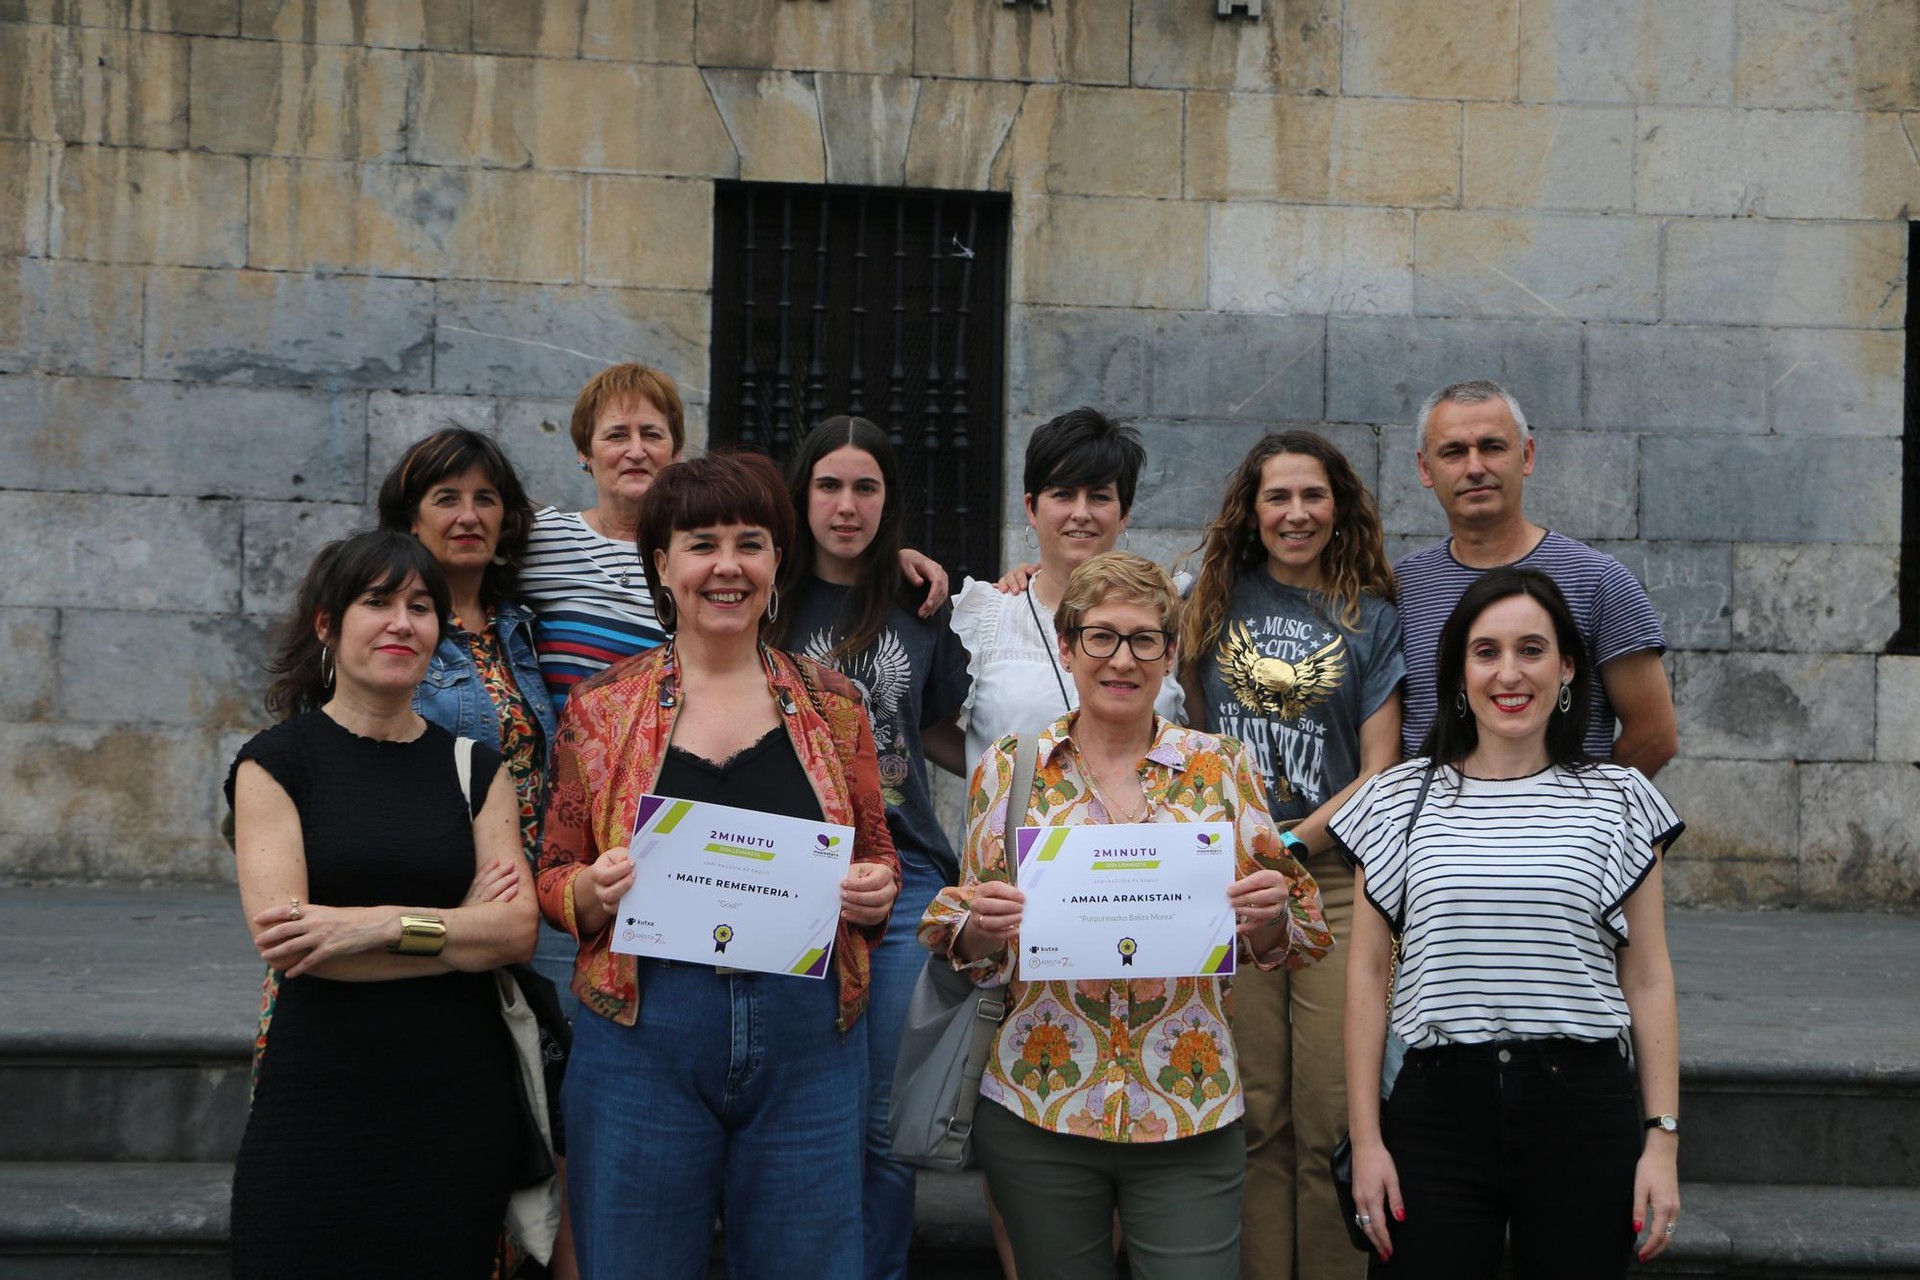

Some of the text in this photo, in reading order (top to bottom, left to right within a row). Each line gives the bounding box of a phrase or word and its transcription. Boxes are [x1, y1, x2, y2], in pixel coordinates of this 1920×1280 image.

[1262, 616, 1312, 640] MUSIC
[1265, 639, 1302, 660] CITY
[1227, 702, 1314, 733] 19 50
[710, 830, 774, 848] 2MINUTU
[1094, 848, 1157, 858] 2MINUTU
[676, 873, 790, 898] MAITE REMENTERIA
[1070, 893, 1182, 903] AMAIA ARAKISTAIN
[637, 918, 654, 926] kutxa
[1128, 913, 1149, 921] Baliza
